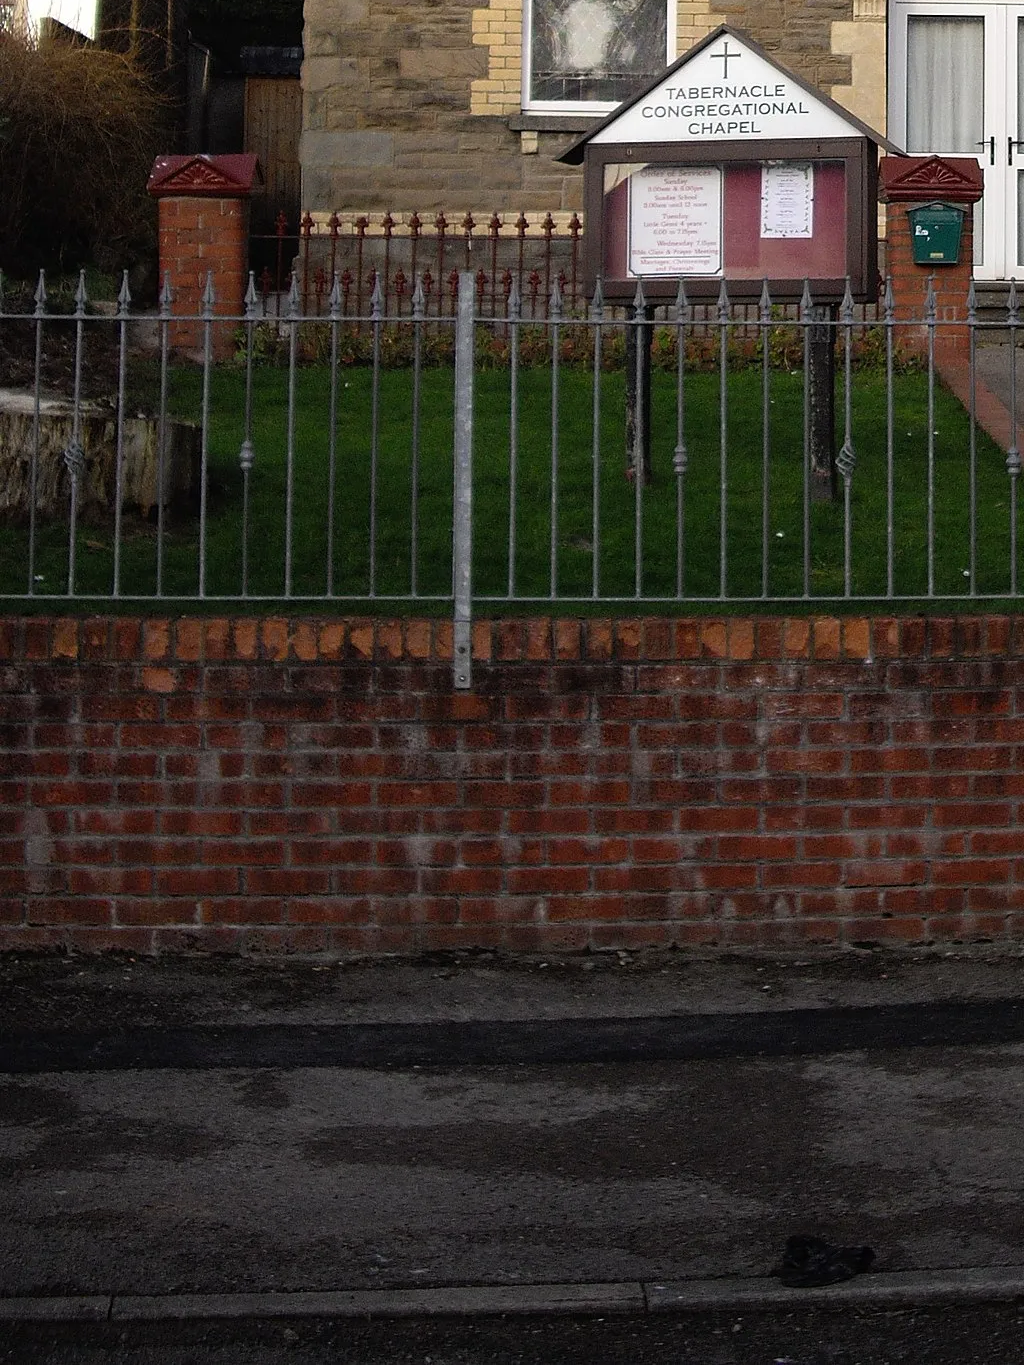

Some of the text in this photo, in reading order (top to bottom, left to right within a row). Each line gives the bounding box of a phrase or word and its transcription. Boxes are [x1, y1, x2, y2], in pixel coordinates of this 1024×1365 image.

[666, 84, 786, 100] TABERNACLE
[641, 102, 809, 119] CONGREGATIONAL
[688, 121, 762, 135] CHAPEL
[663, 178, 688, 186] Sunday
[661, 213, 688, 221] Tuesday
